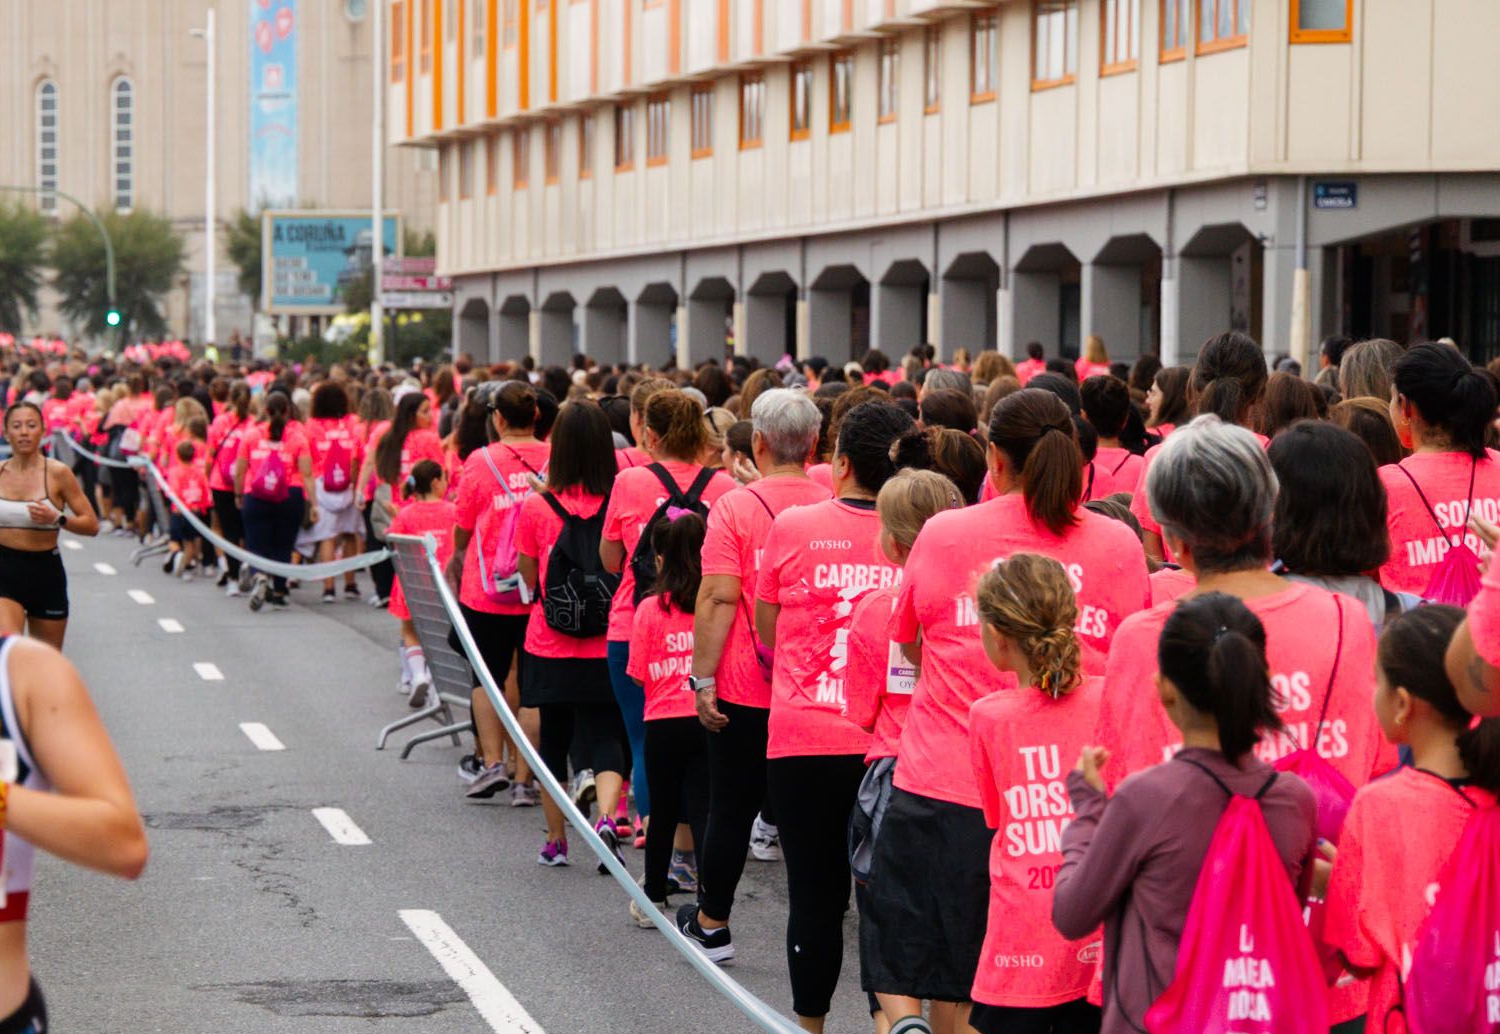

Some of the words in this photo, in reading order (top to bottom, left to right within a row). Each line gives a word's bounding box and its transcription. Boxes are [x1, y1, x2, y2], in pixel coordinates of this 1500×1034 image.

[274, 225, 282, 241] A
[1434, 497, 1500, 529] SOMO
[810, 540, 851, 550] OYSHO
[1019, 744, 1061, 781] TU
[1006, 818, 1071, 857] SUM
[995, 955, 1044, 968] OYSHO
